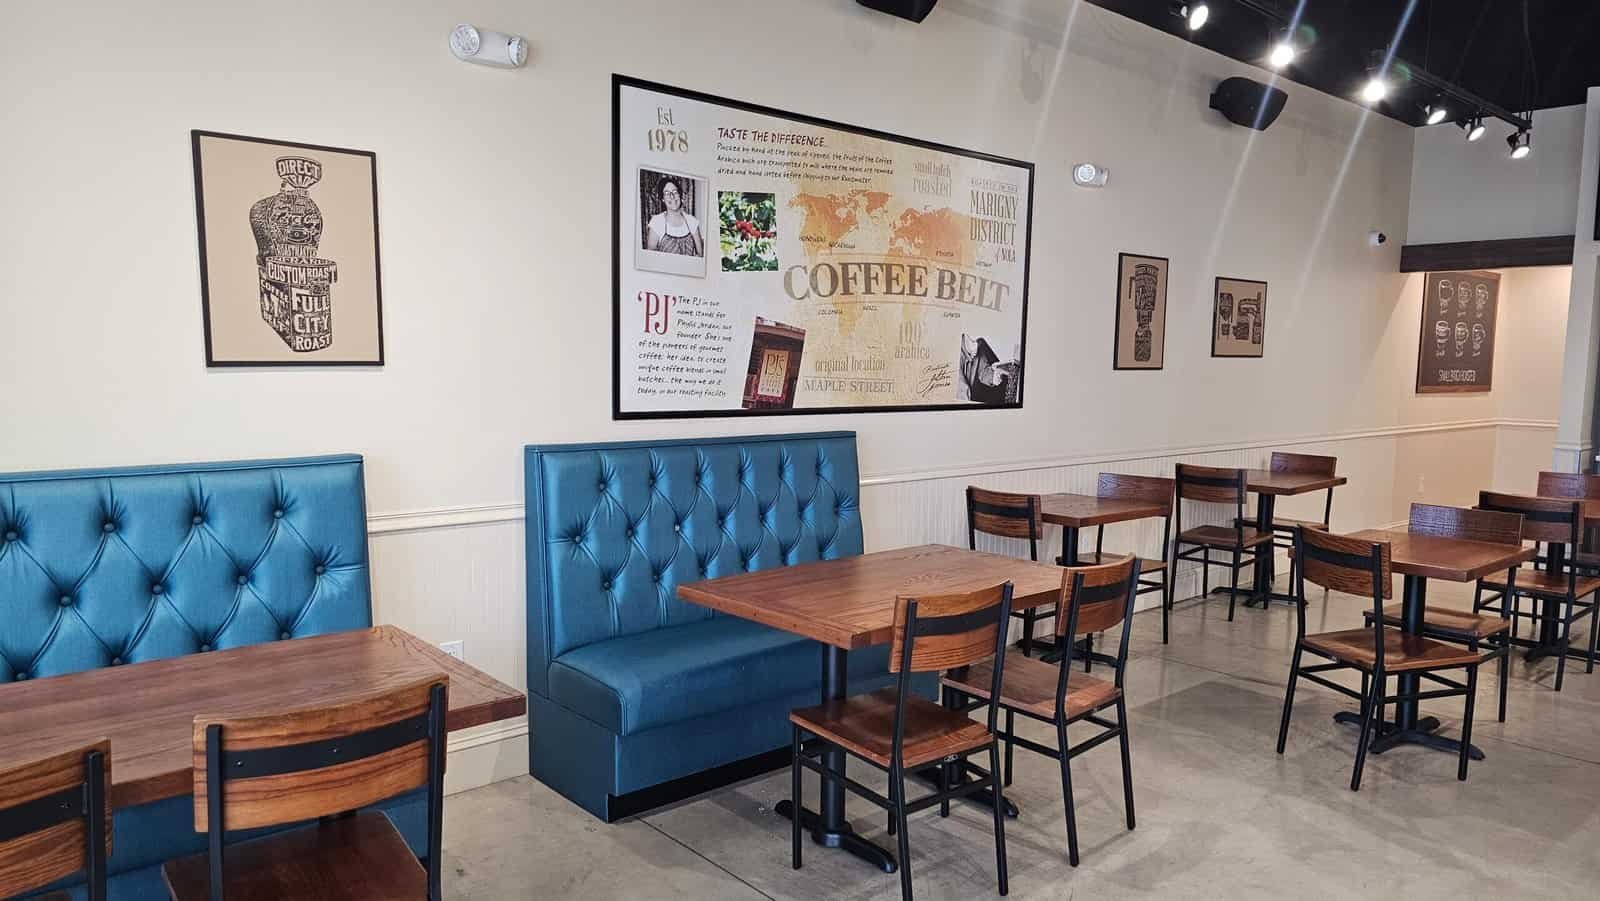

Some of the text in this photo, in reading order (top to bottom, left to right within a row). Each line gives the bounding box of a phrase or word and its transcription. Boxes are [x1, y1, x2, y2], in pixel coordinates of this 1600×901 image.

[657, 106, 675, 126] Est
[648, 128, 689, 152] 1978
[718, 127, 748, 140] TASTE
[752, 130, 769, 142] THE
[277, 160, 321, 181] DIRECT
[717, 167, 734, 176] dried
[970, 190, 1018, 220] MARIGNY
[969, 217, 1016, 246] DISTRICT
[268, 261, 307, 285] CUSTOM
[783, 262, 1010, 313] COFFEE BELT
[291, 287, 330, 313] FULL
[679, 295, 691, 305] The
[692, 296, 702, 306] PJ
[677, 309, 693, 317] name
[293, 313, 329, 334] CITY
[295, 334, 331, 351] ROAST
[667, 352, 678, 360] her
[815, 354, 849, 376] original
[662, 364, 684, 372] coffee
[671, 376, 682, 384] the
[804, 378, 847, 393] MAPLE
[849, 379, 895, 394] STREET
